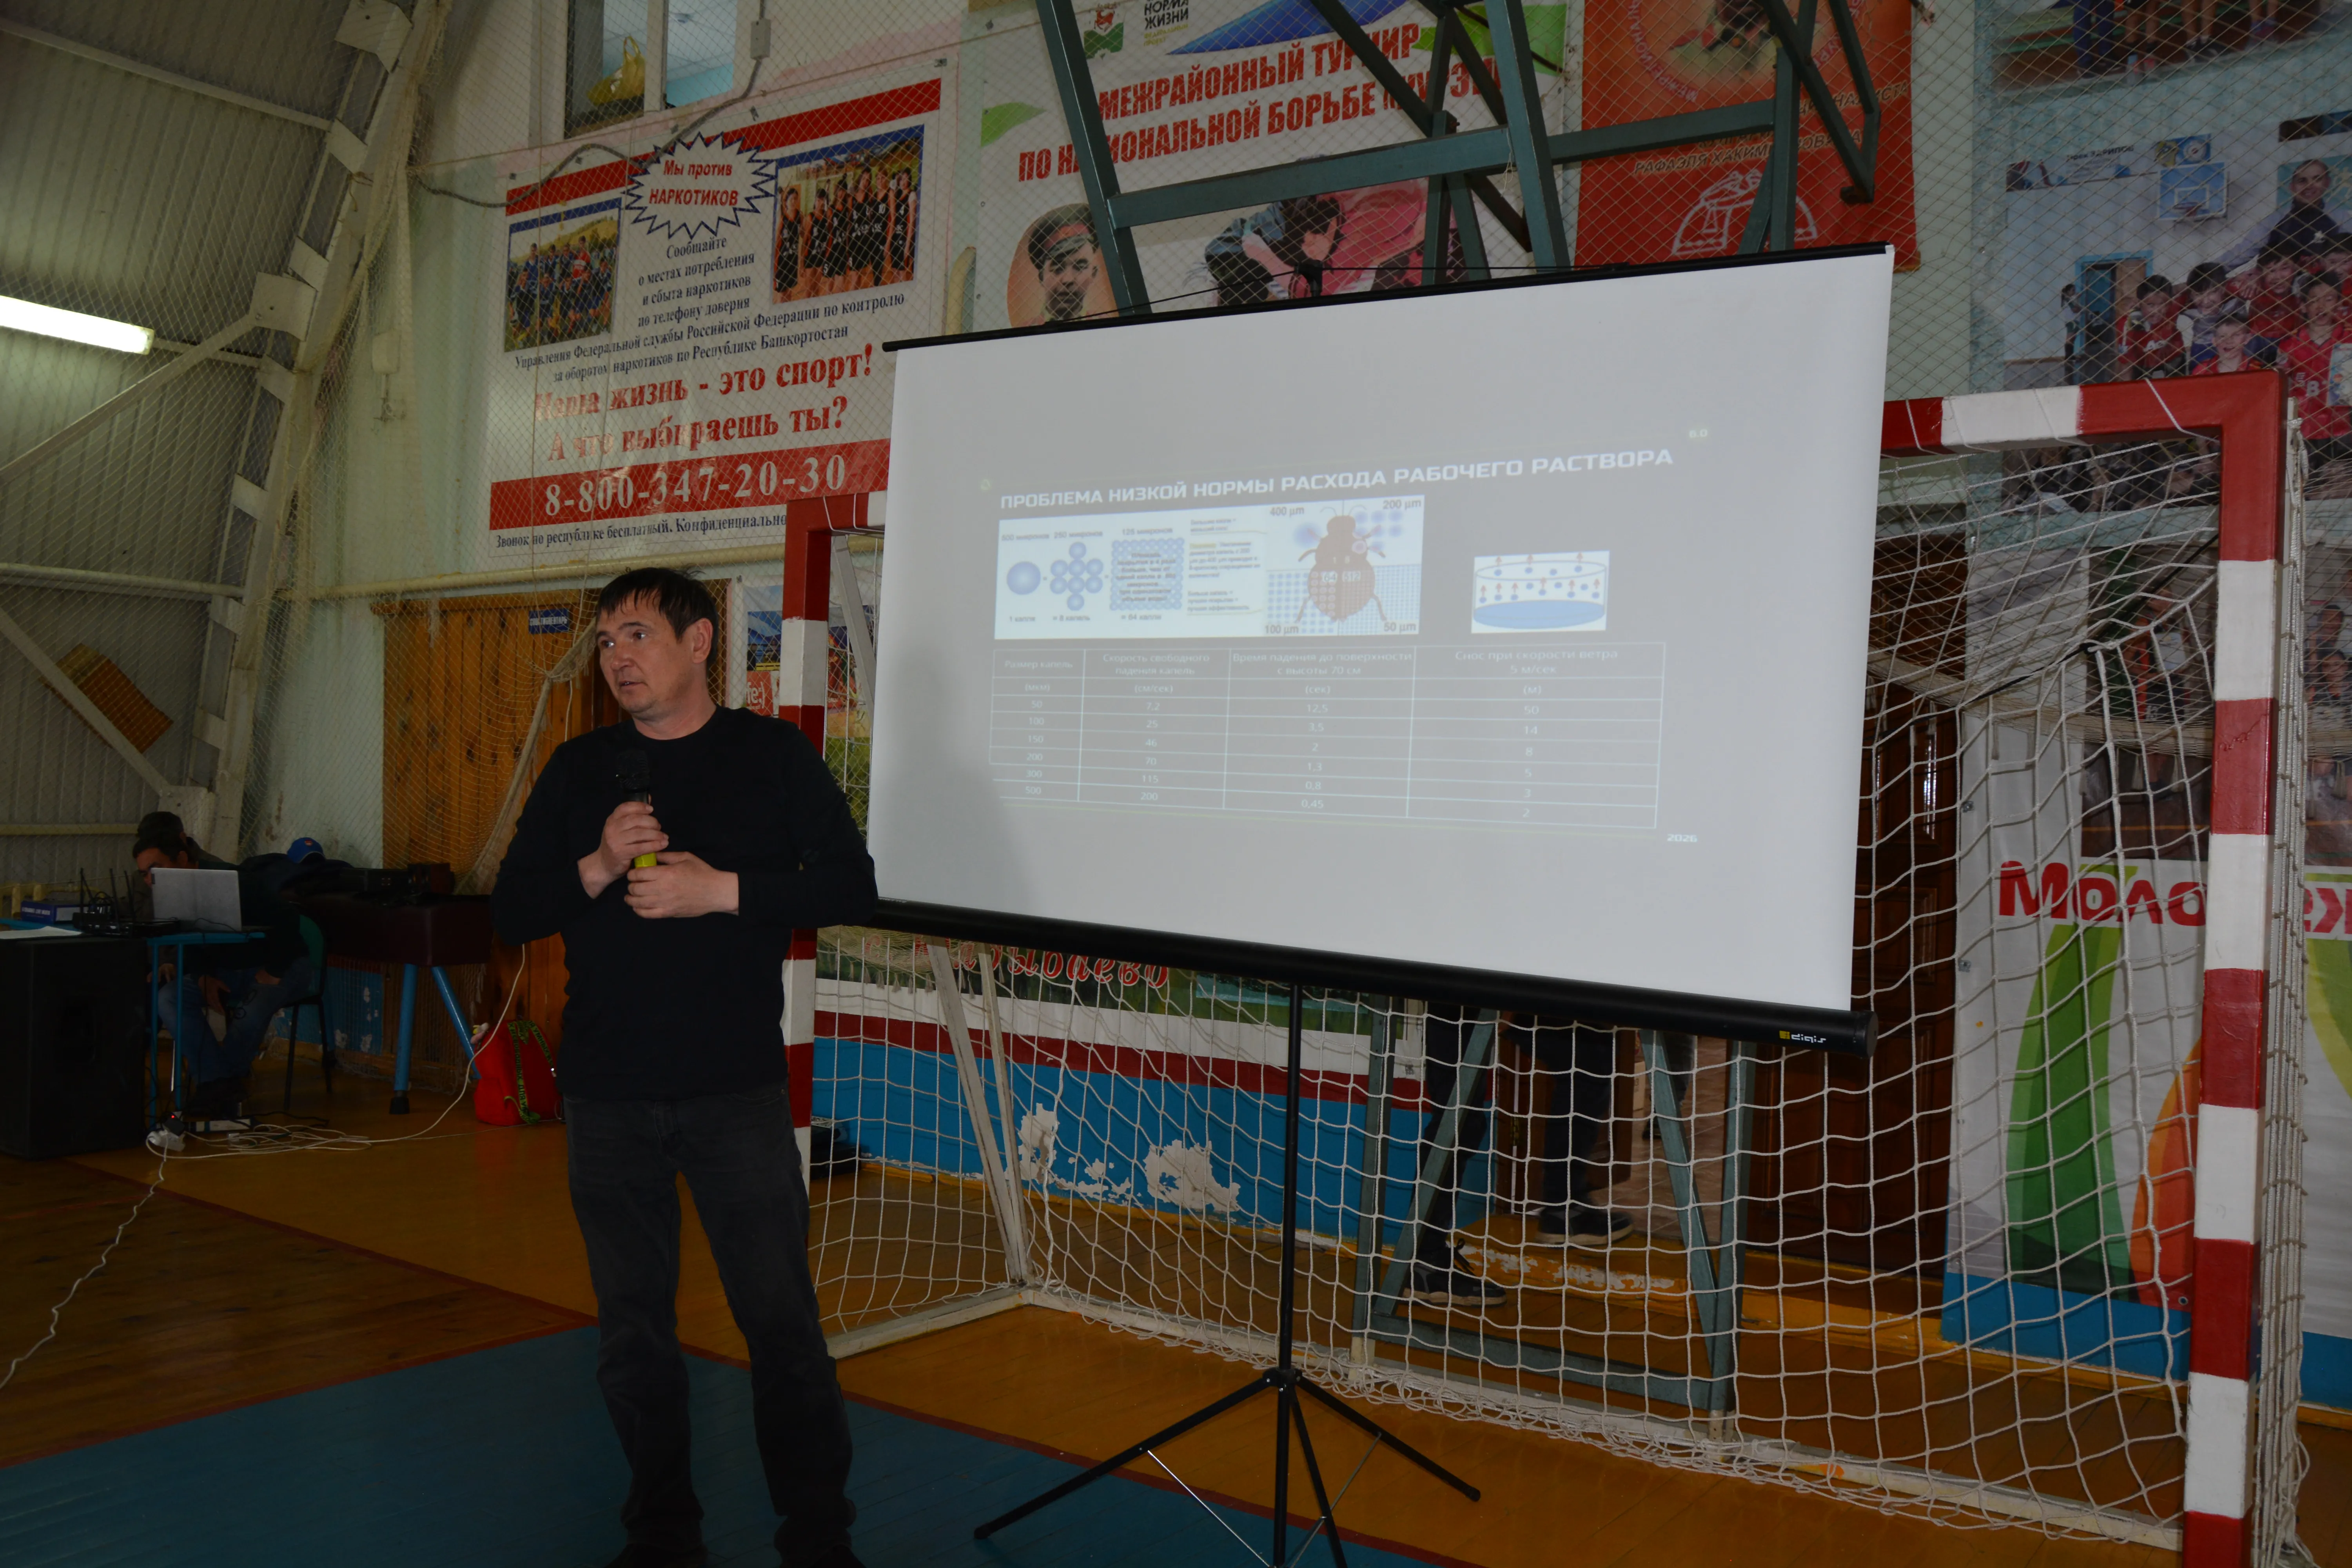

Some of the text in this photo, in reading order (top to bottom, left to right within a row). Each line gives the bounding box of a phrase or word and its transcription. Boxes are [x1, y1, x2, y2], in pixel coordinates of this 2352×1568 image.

[1145, 7, 1189, 30] ЖИЗНИ
[1099, 42, 1304, 121] МЕЖРАЙОННЫЙ
[1019, 149, 1051, 181] ПО
[1058, 100, 1260, 176] НИОНАЛЬНОЙ
[1268, 82, 1376, 135] БОРЬБЕ
[664, 159, 733, 180] Мы против
[649, 187, 739, 207] НАРКОТИКОВ
[666, 236, 727, 259] Сообщайте
[638, 252, 755, 287] о местах потребления
[642, 276, 751, 305] и сбыта наркотиков
[638, 298, 750, 329] по телефону доверия
[514, 293, 905, 372] Управления Федеральной службы Российской Федерации по контролю
[553, 324, 848, 383] за оборотом наркотиков по Республике Башкортостан
[535, 390, 600, 421] Наша
[610, 376, 688, 410] жизнь
[720, 364, 766, 395] это
[775, 342, 873, 393] спорт!
[548, 395, 848, 461] А что выбираешь ты?
[1001, 450, 1674, 508] ПРОБЛЕМА НИЗКОЙ НОРМЫ РАСХОДА РАБОЧЕГО РАСТВОРА
[545, 454, 845, 516] 8-800-347-20-30
[1383, 500, 1401, 509] 200
[1270, 507, 1287, 516] 400
[496, 532, 529, 548] Звонок
[532, 532, 544, 546] по
[546, 525, 604, 548] республике
[606, 516, 673, 539] бесплатный.
[1265, 625, 1281, 633] 100
[1384, 623, 1396, 631] 50
[1103, 653, 1209, 664] Скорость свободного
[1233, 652, 1412, 663] Время падения до поверхности
[1455, 650, 1618, 662] Снос при скорости ветра
[1005, 660, 1073, 670] Размер капель
[1522, 664, 1557, 675] м/сек
[1116, 667, 1195, 675] падения капель
[1134, 683, 1173, 694] (см/сек)
[1305, 684, 1331, 695] (сек)
[1523, 684, 1542, 696] (м)
[1031, 700, 1043, 708] 50
[1524, 706, 1539, 715] 50
[1029, 717, 1044, 726] 100
[1146, 720, 1158, 728] 25
[1524, 725, 1538, 735] 14
[1027, 735, 1044, 743] 150
[1145, 738, 1157, 747] 46
[1027, 753, 1043, 761] 200
[1145, 757, 1156, 766] 70
[1026, 770, 1042, 778] 300
[1142, 775, 1158, 783] 115
[1025, 786, 1042, 795] 500
[1141, 792, 1158, 800] 200
